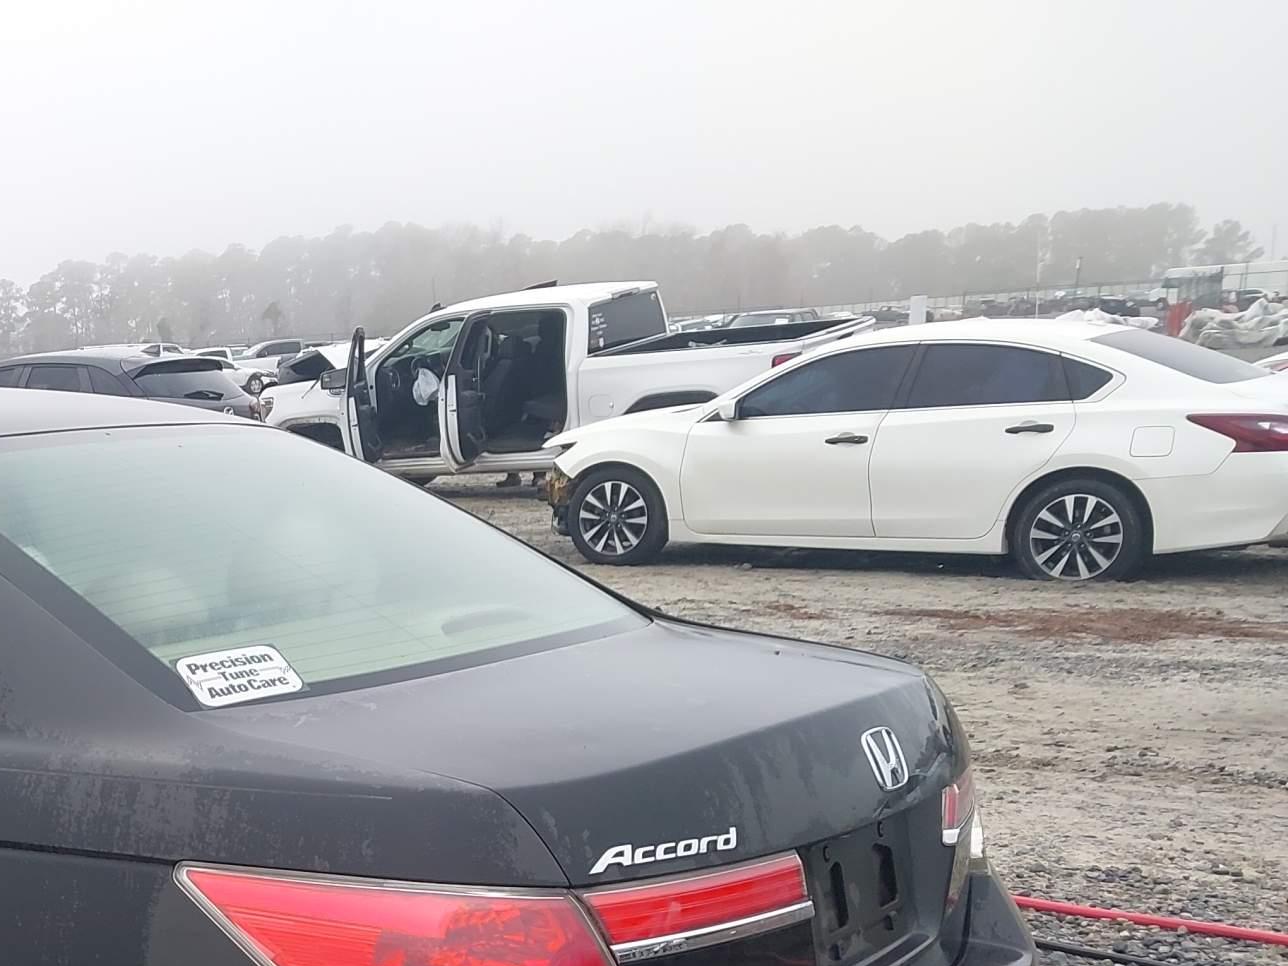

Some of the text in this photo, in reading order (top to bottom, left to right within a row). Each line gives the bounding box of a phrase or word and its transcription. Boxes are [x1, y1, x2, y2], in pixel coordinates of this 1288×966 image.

[186, 652, 274, 675] Precision
[219, 668, 259, 682] Tune
[588, 826, 737, 875] Accord
